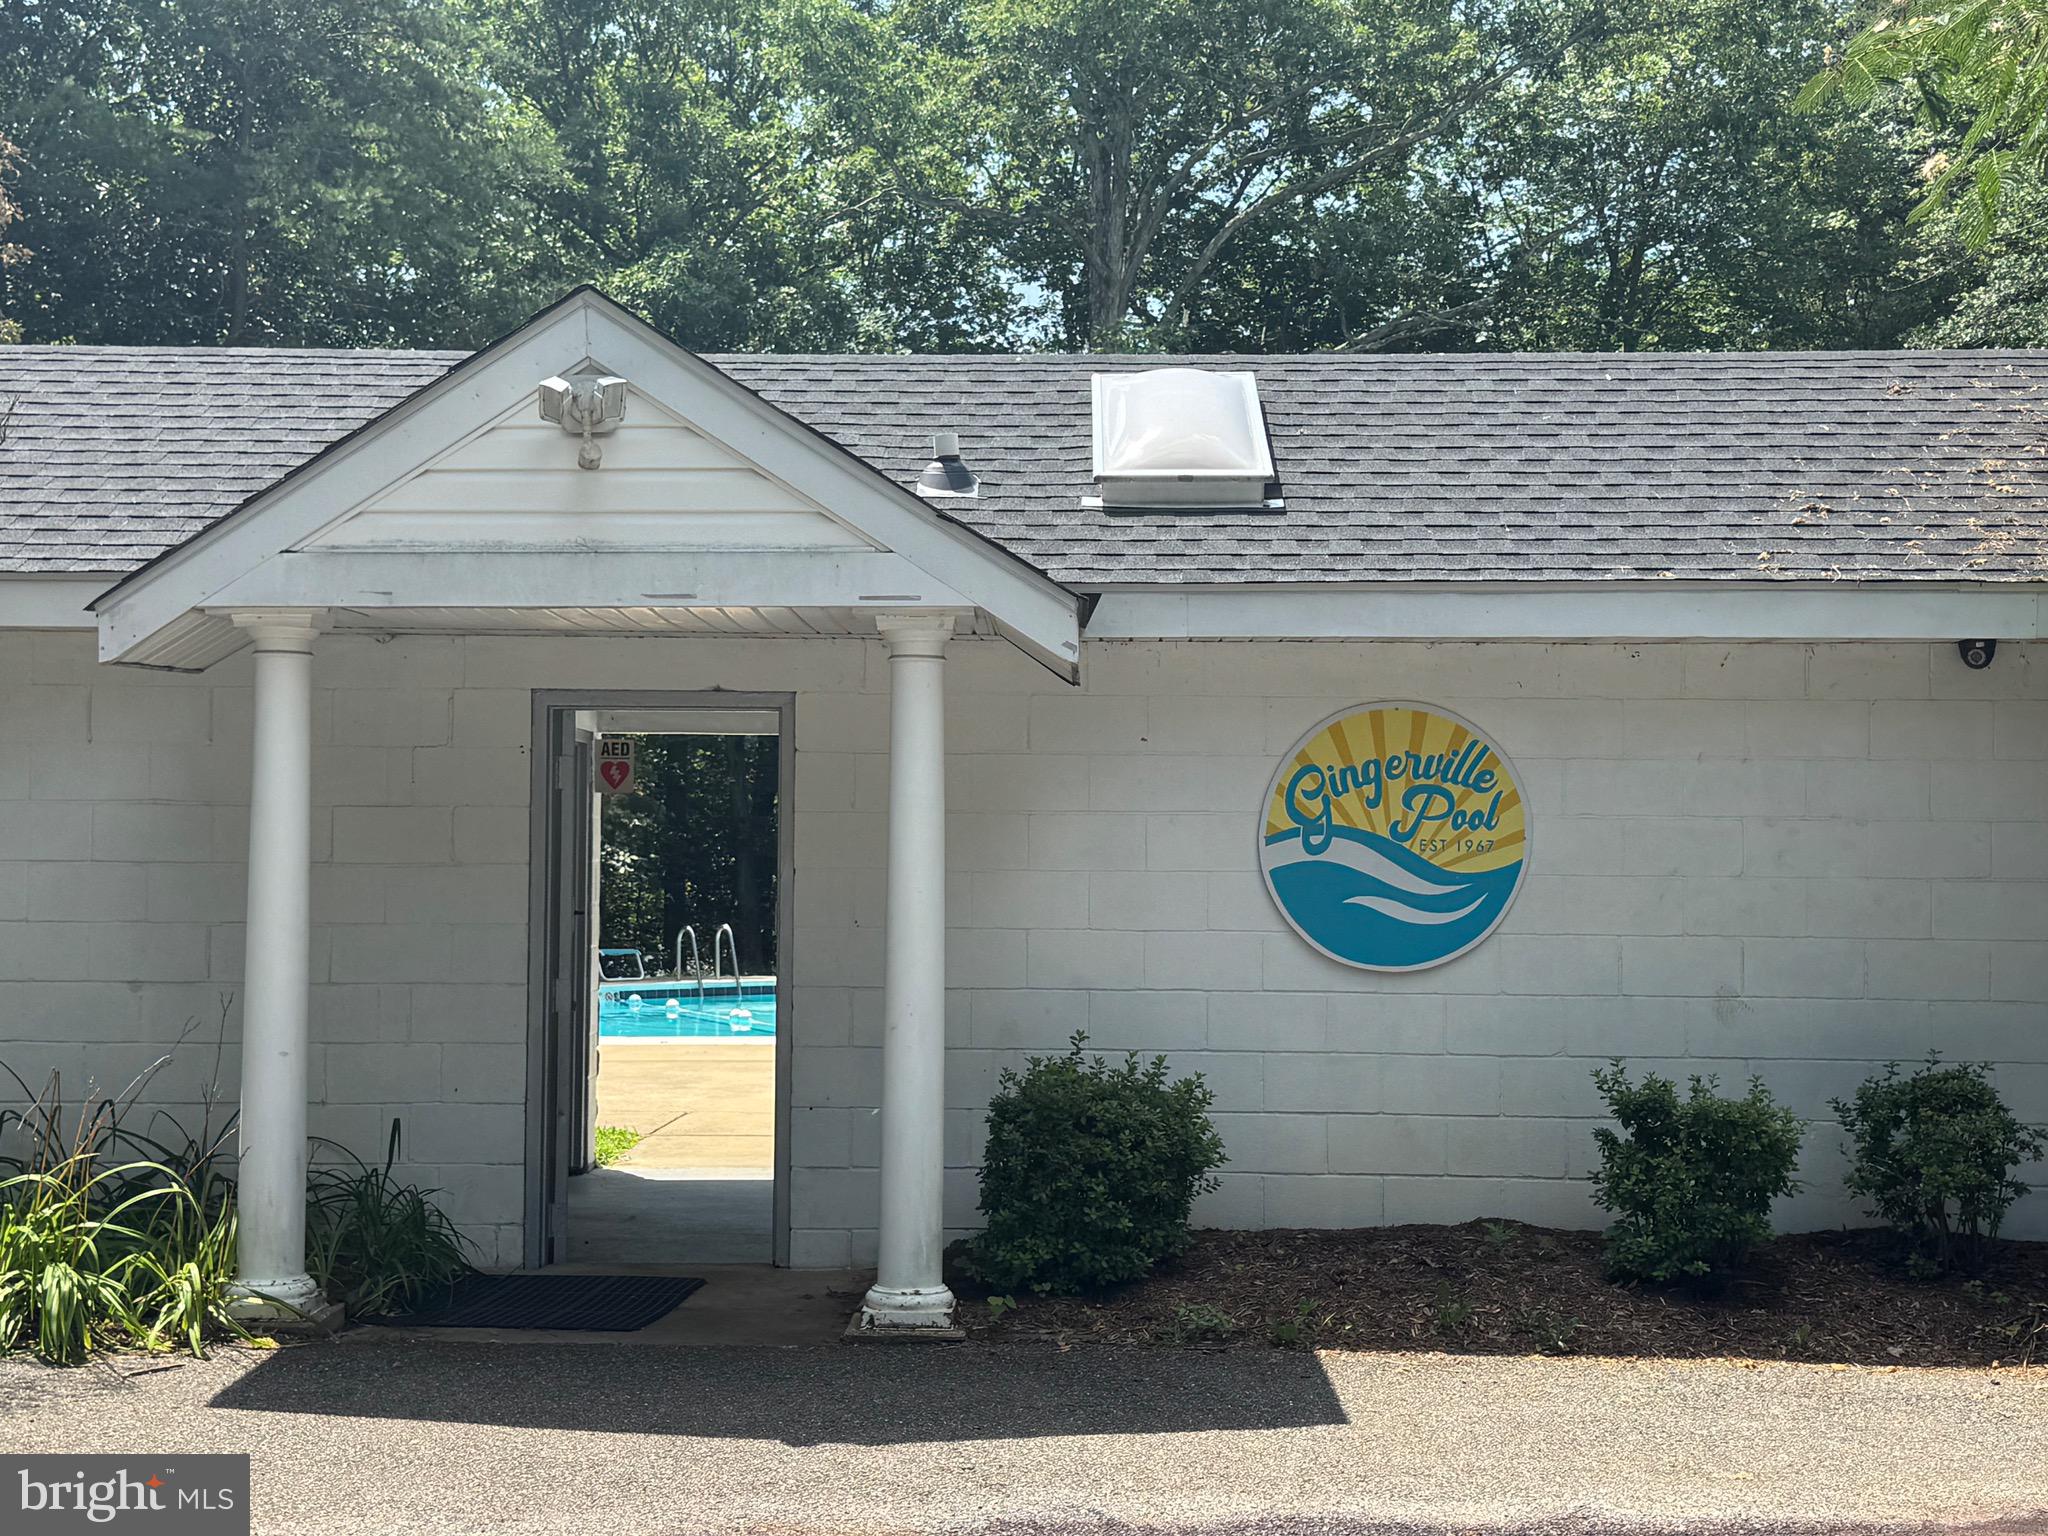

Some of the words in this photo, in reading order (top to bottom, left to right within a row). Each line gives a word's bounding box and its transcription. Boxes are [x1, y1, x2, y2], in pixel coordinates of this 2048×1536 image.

[601, 741, 630, 757] AED
[1285, 739, 1498, 856] Gingerville
[1389, 784, 1503, 842] Pool
[1419, 839, 1447, 852] EST
[1456, 840, 1495, 853] 1967
